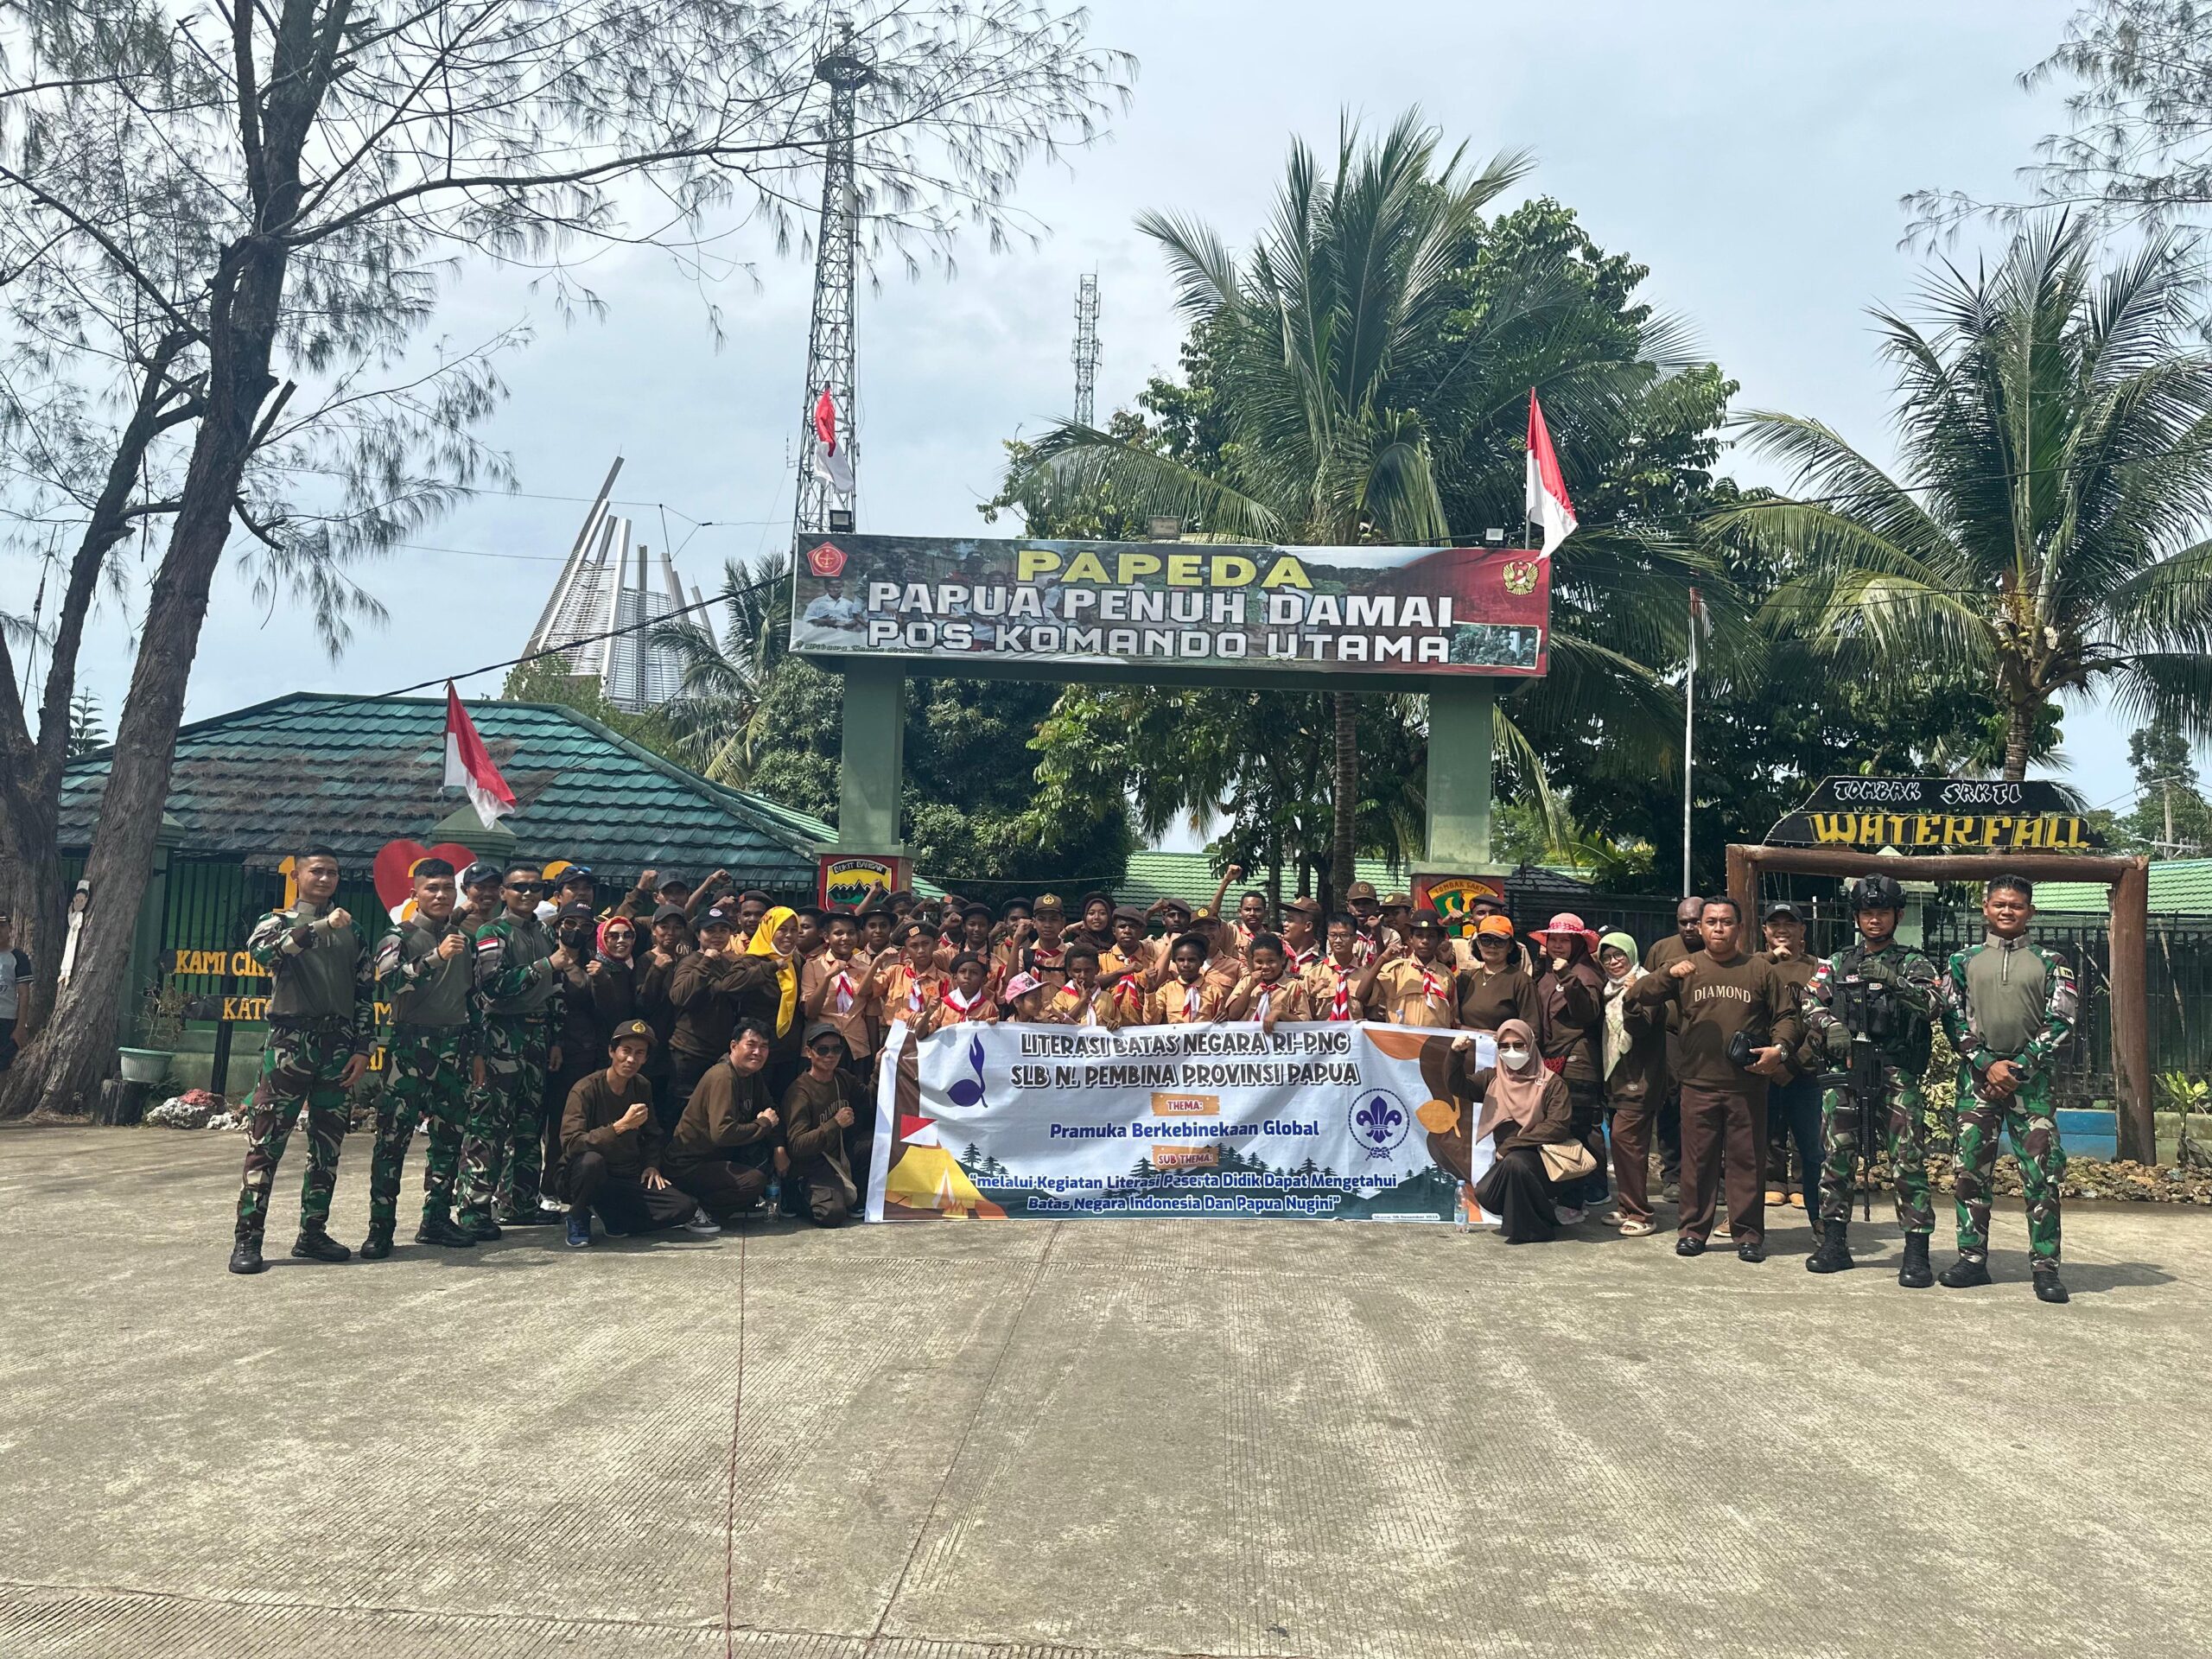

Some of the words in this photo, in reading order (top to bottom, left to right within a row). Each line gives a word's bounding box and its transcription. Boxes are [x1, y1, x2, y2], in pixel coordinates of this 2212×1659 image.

[1017, 549, 1313, 589] PAPEDA
[868, 582, 1045, 619] PAPUA
[1063, 588, 1246, 625] PENUH
[1268, 592, 1452, 628] DAMAI
[867, 619, 975, 652] POS
[995, 623, 1249, 659] KOMANDO
[1267, 631, 1450, 664] UTAMA
[1812, 813, 2091, 848] WATERFALL
[174, 950, 226, 975] KAMI
[1694, 985, 1751, 1003] DIAMOND
[1020, 1033, 1110, 1058] LITERASI
[1113, 1033, 1181, 1058] BATAS
[1183, 1032, 1269, 1055] NEGARA
[1272, 1031, 1351, 1055] RI-PNG
[1011, 1064, 1051, 1089] SLB
[1084, 1064, 1179, 1088] PEMBINA
[1182, 1062, 1283, 1087] PROVINSI
[1287, 1062, 1361, 1086] PAPUA
[1166, 1099, 1203, 1111] THEMA:
[1050, 1122, 1127, 1139] Pramuka
[1132, 1121, 1258, 1138] Berkebinekaan
[1262, 1119, 1319, 1136] Global
[1158, 1154, 1177, 1165] SUB
[1179, 1153, 1213, 1165] THEMA:
[1037, 1175, 1104, 1192] Kegiatan
[1107, 1174, 1160, 1190] Literasi
[1161, 1173, 1220, 1188] Peserta
[1223, 1173, 1262, 1188] Didik
[1264, 1173, 1308, 1192] Dapat
[1311, 1173, 1398, 1192] Mengetahui
[1027, 1197, 1071, 1211] Batas
[1074, 1197, 1127, 1214] Negara
[1129, 1194, 1201, 1211] Indonesia
[1204, 1196, 1233, 1211] Dan
[1236, 1196, 1284, 1215] Papua
